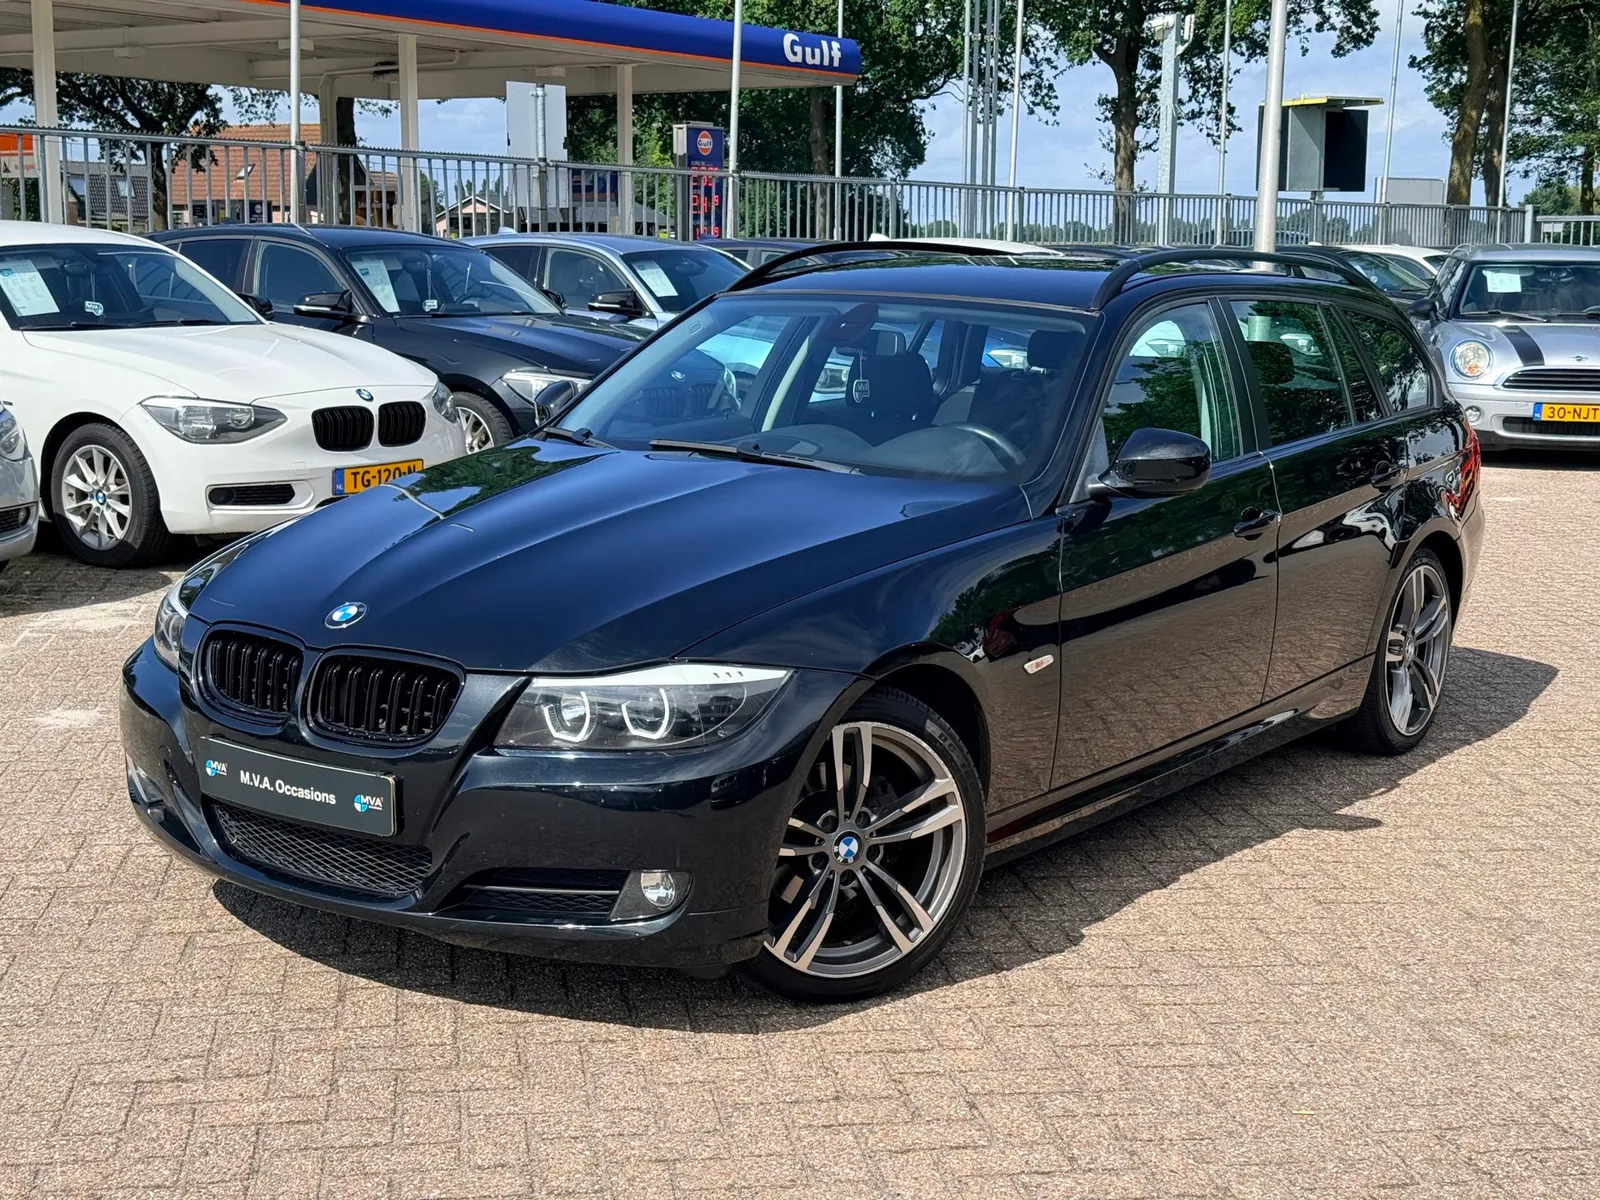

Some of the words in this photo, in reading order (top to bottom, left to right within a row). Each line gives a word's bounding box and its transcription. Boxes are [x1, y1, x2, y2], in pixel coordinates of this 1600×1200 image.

[783, 32, 842, 67] Gulf
[697, 139, 712, 147] Gulf
[1548, 406, 1600, 421] 30-NJT
[240, 770, 274, 791] M.V.A.
[275, 779, 337, 805] Occasions
